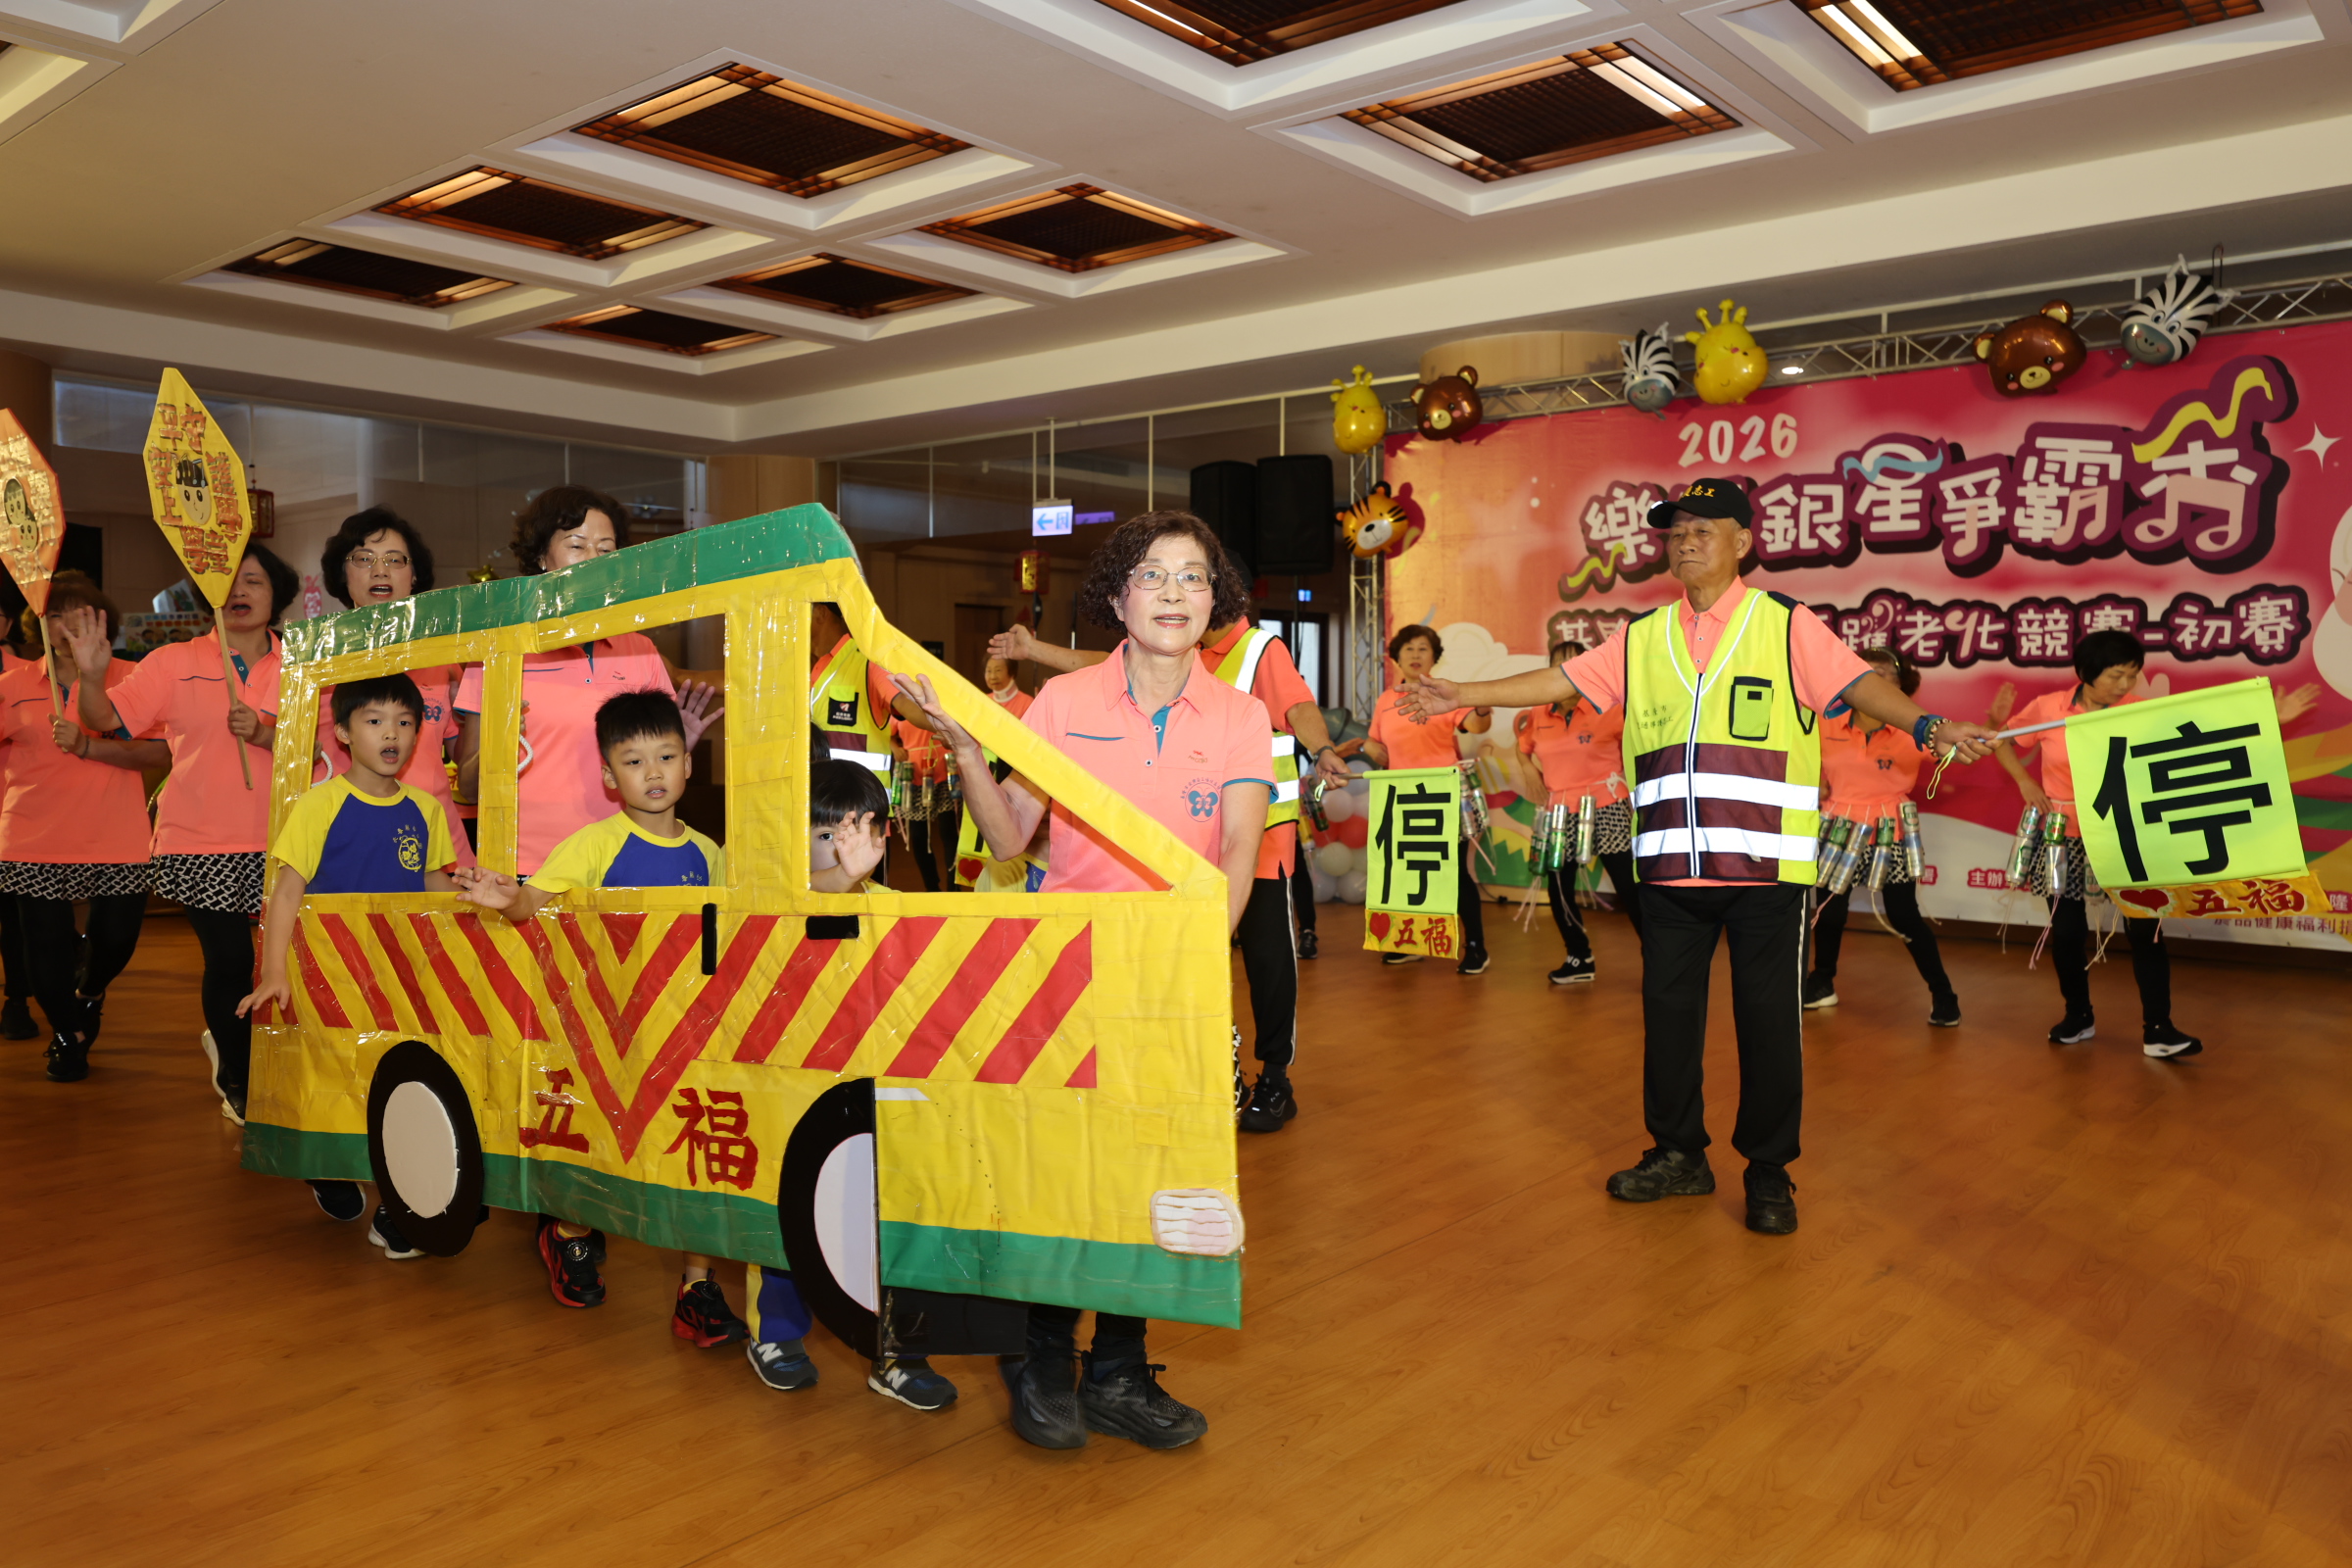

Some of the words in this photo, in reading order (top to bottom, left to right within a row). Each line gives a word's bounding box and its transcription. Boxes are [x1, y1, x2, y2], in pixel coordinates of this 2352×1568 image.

[1570, 368, 2274, 585] 樂銀星爭霸秀
[1678, 413, 1798, 467] 2026
[1375, 782, 1452, 906] 停
[2092, 720, 2274, 883] 停
[1394, 917, 1454, 956] 五福
[2185, 879, 2306, 917] 五福
[519, 1067, 759, 1192] 五福
[885, 1367, 910, 1390] N
